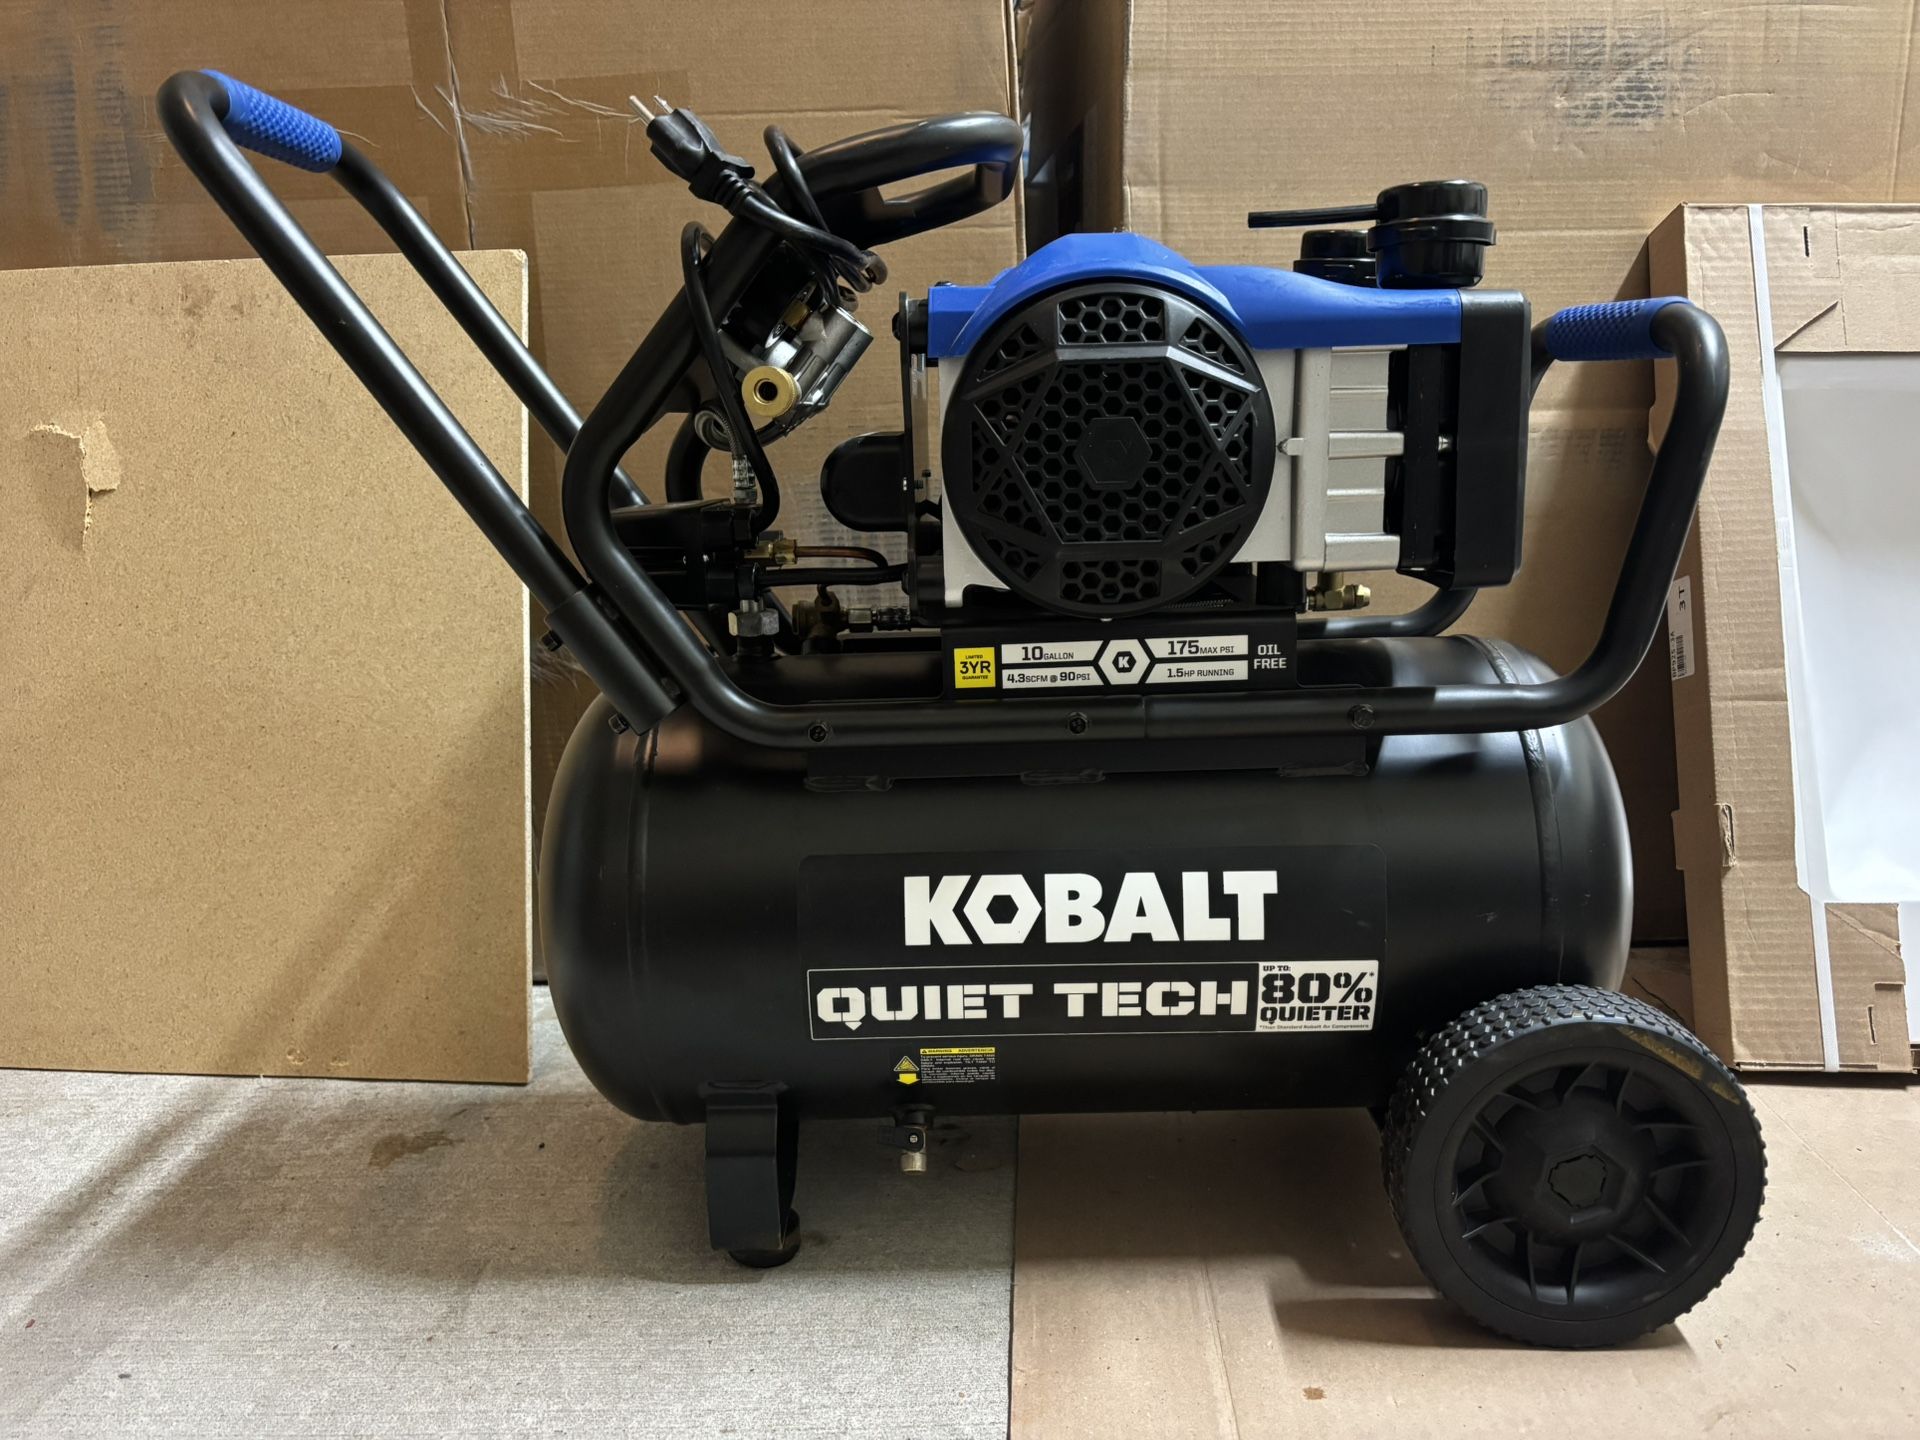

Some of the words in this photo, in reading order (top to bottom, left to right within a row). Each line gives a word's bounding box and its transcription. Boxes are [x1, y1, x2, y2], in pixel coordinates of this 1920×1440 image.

[1257, 644, 1281, 656] OIL
[960, 660, 991, 674] 3YR
[1118, 656, 1130, 668] K
[1253, 657, 1287, 669] FREE
[1197, 668, 1235, 677] RUNNING
[903, 870, 1278, 946] KOBALT
[816, 983, 1034, 1031] QUIET
[1053, 980, 1249, 1018] TECH
[1260, 1005, 1371, 1025] QUIETER
